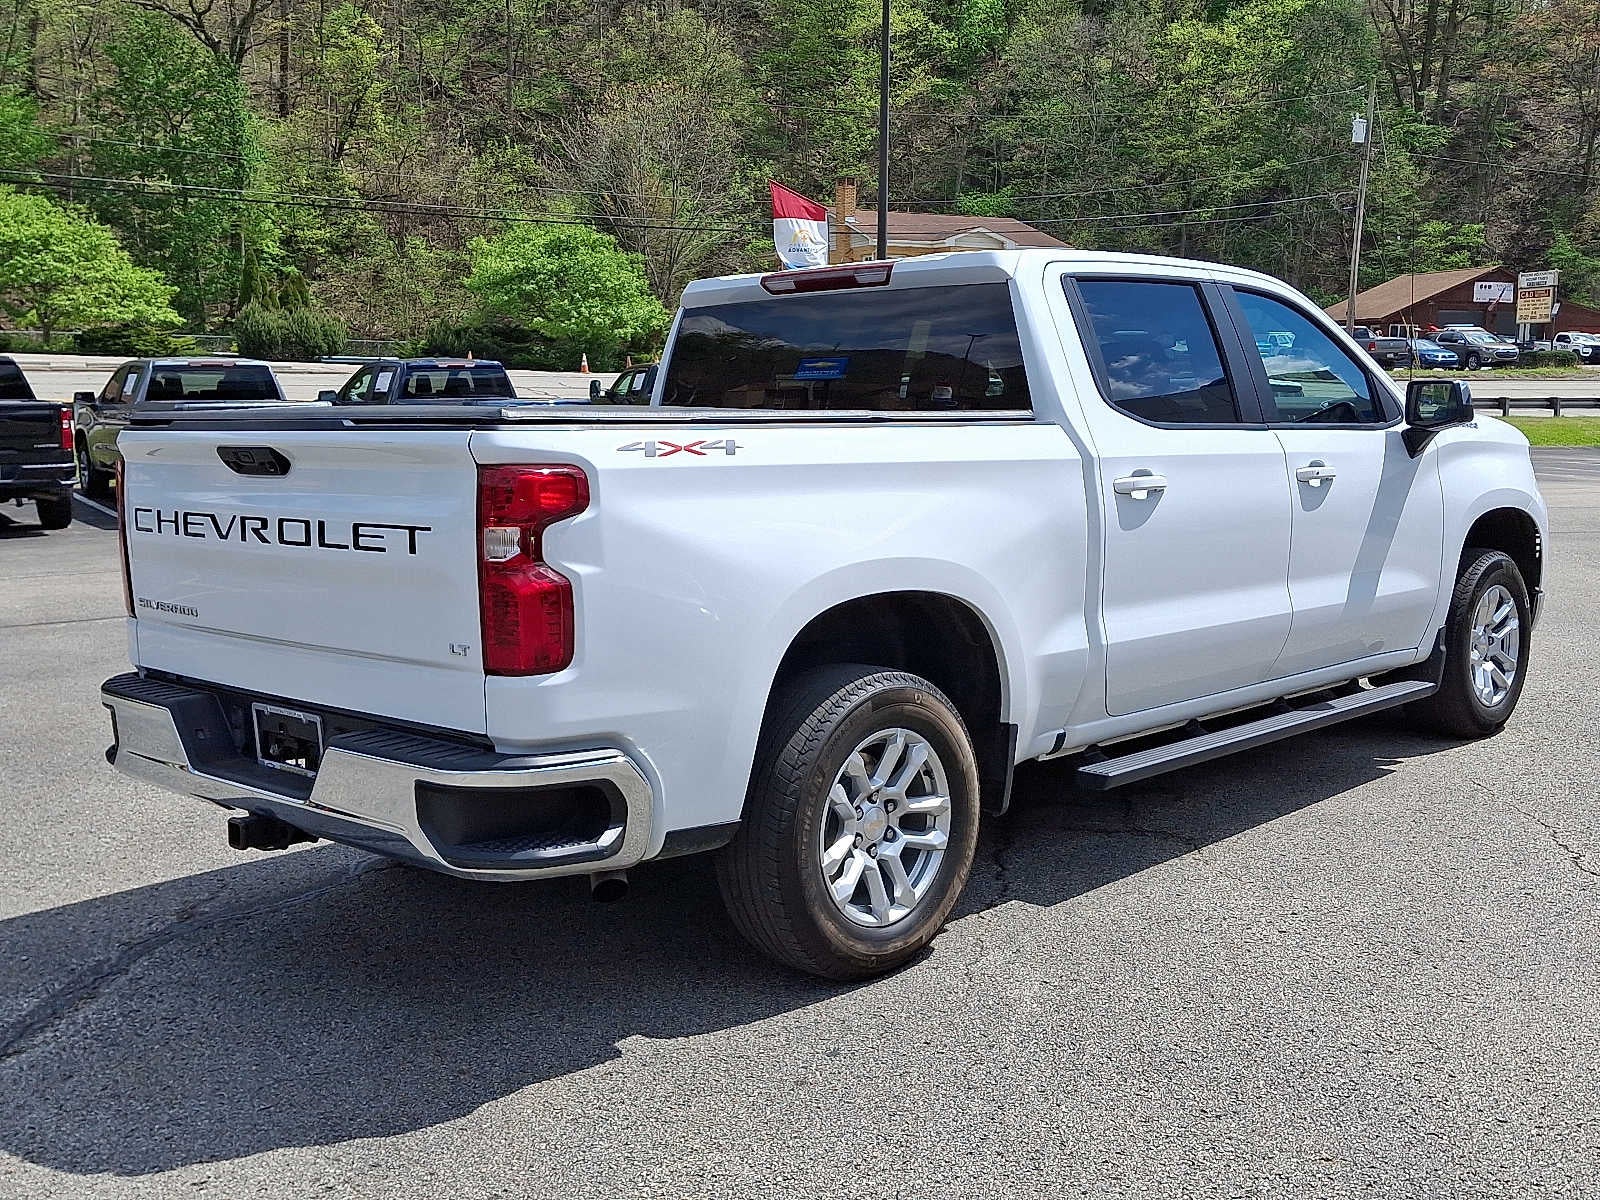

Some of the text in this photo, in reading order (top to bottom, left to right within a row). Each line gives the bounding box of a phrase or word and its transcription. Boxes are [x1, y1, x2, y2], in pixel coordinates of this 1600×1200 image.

[134, 507, 432, 555] CHEVROLET
[138, 597, 199, 618] SILVERADO
[449, 642, 470, 656] LT
